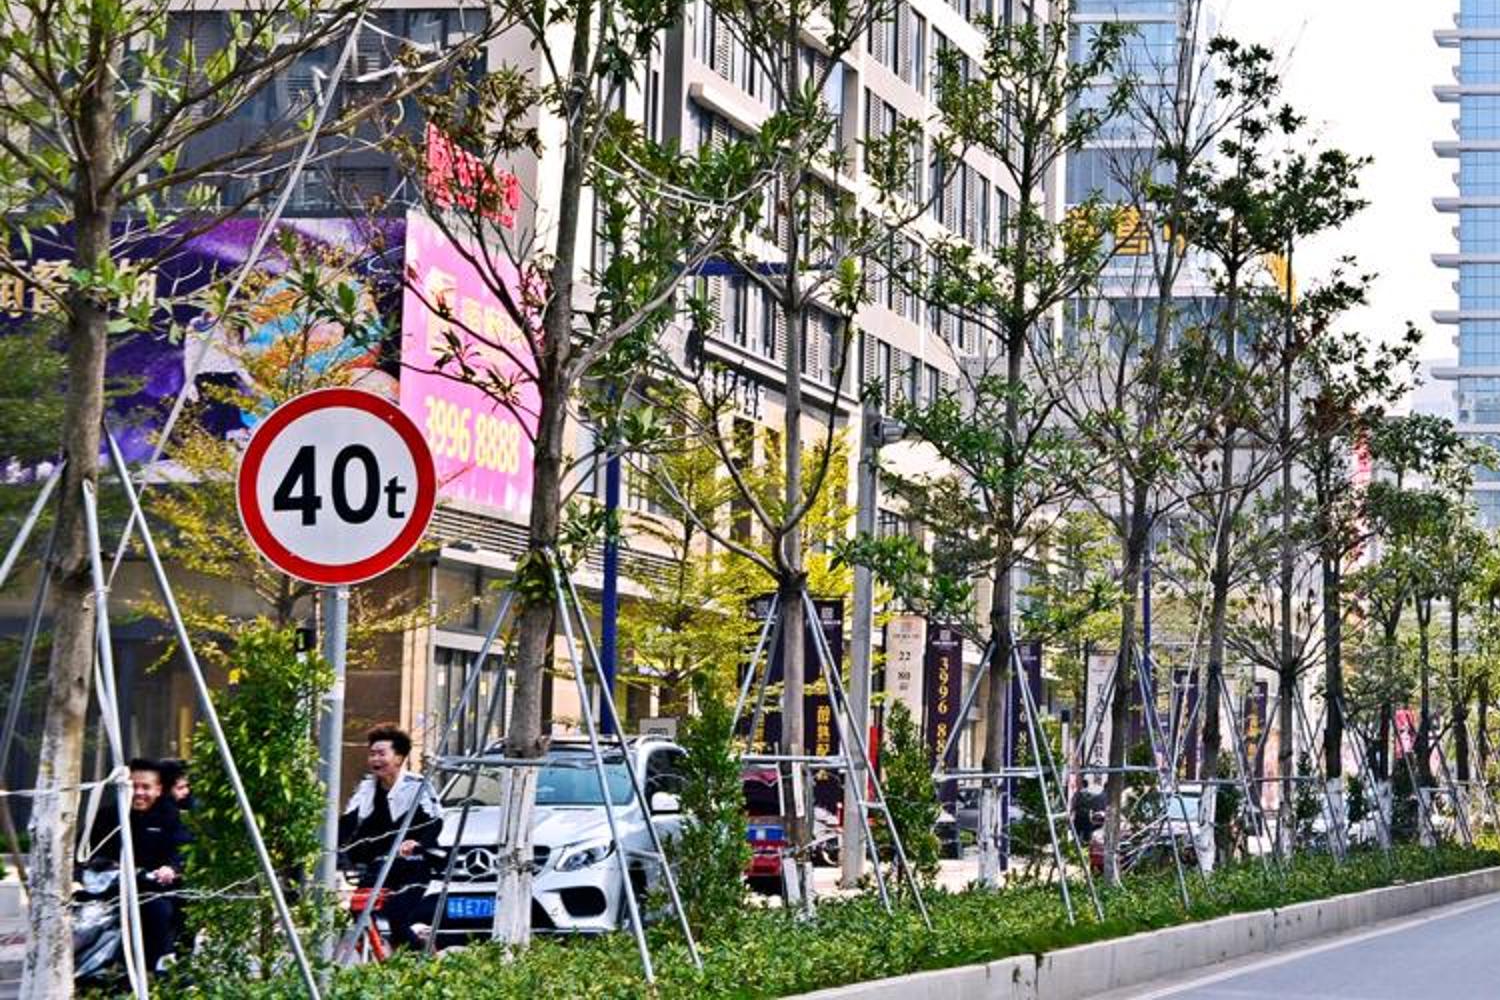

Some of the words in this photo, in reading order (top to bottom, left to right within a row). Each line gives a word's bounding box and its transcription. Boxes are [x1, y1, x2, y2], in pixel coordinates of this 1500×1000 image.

[424, 396, 471, 463] 3996
[475, 411, 520, 474] 8888
[273, 443, 406, 526] 40t
